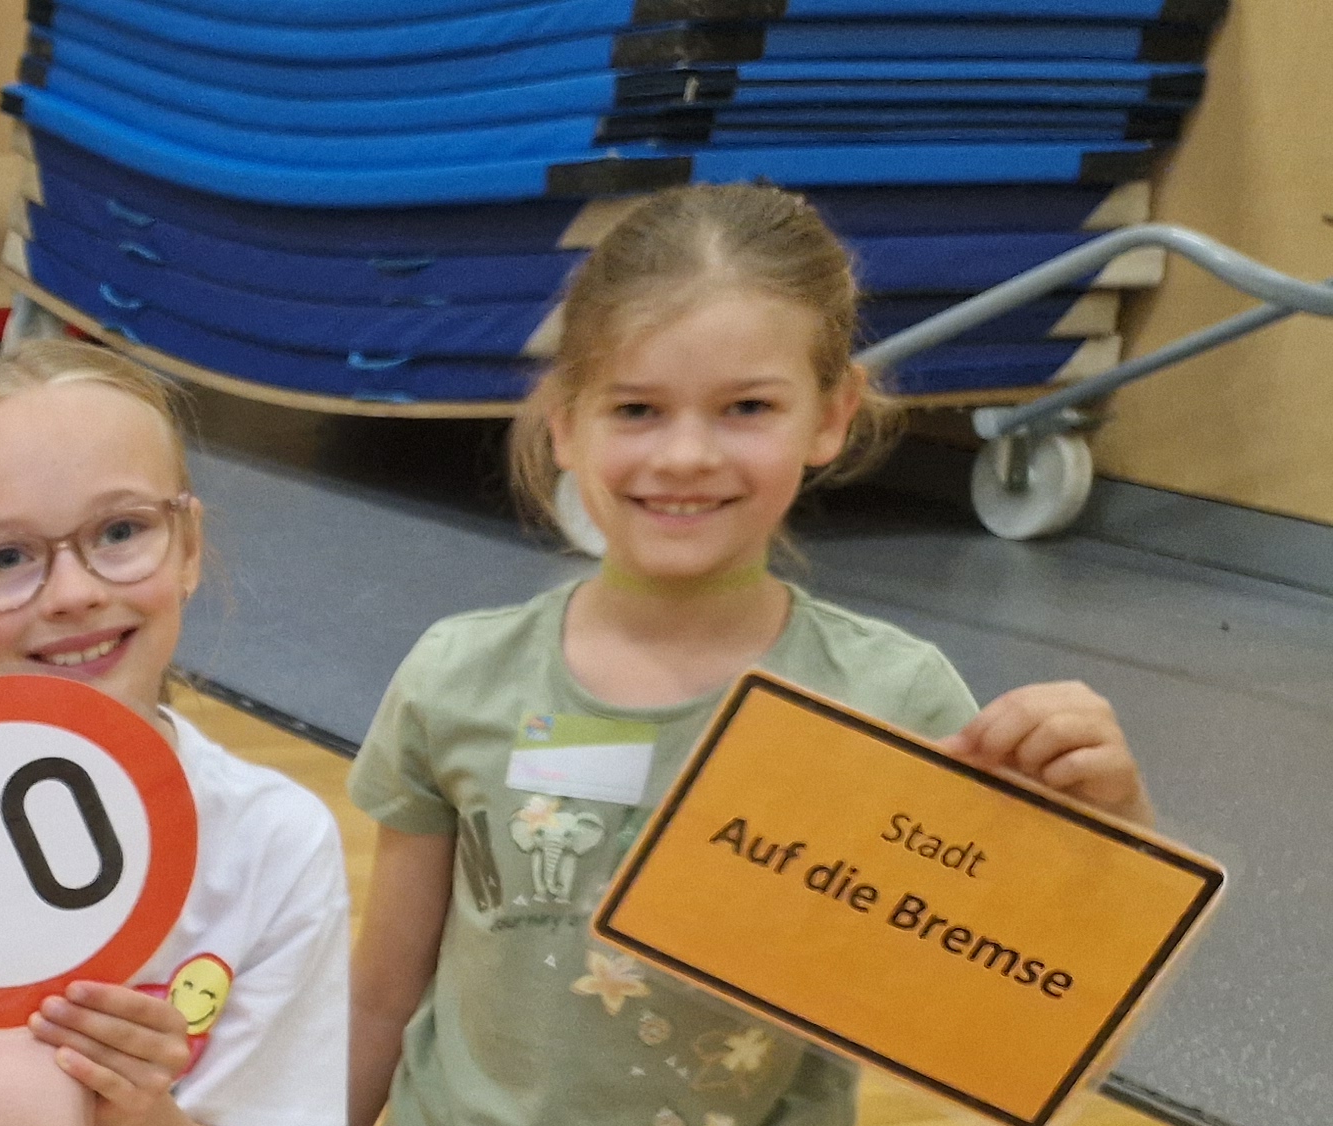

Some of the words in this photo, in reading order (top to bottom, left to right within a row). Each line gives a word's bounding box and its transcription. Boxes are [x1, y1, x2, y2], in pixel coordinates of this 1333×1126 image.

[881, 812, 988, 877] Stadt
[709, 816, 807, 875] Auf
[804, 858, 879, 913] die
[887, 893, 1075, 1000] Bremse
